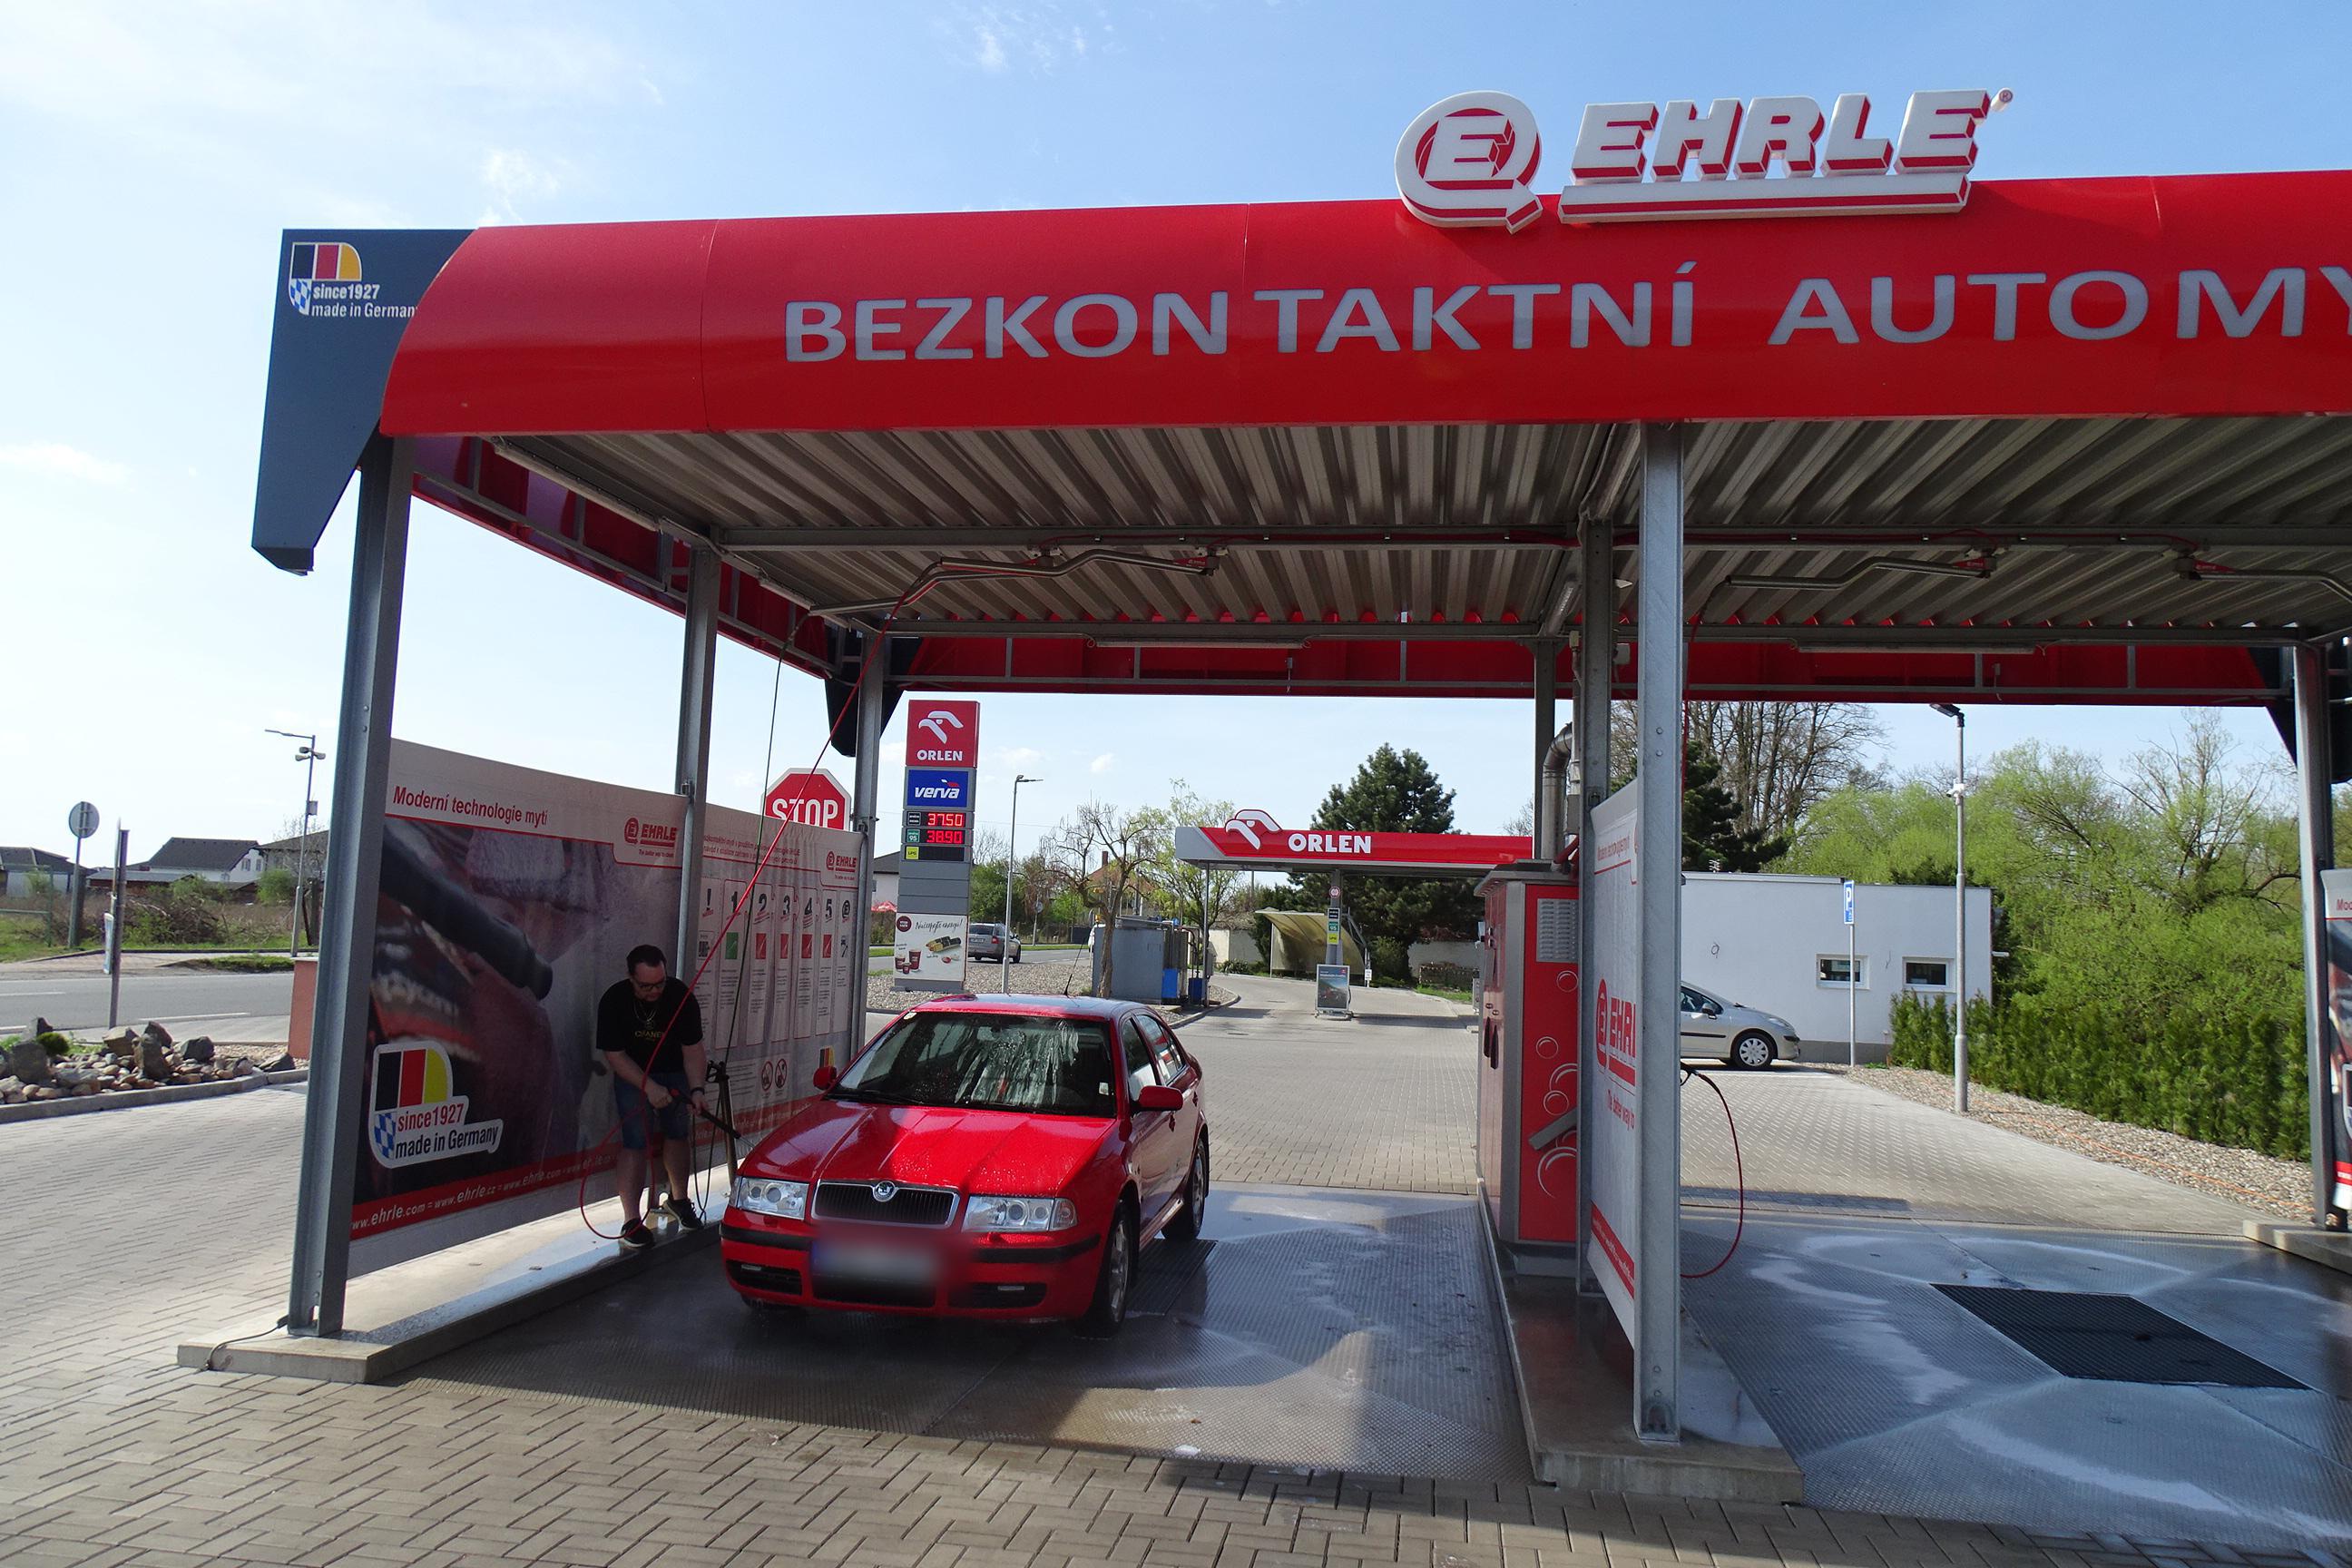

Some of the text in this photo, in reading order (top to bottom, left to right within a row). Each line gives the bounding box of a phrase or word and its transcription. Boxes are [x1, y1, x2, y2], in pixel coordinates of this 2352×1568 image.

[1571, 88, 1991, 185] EHRLE
[311, 302, 417, 318] made in German
[916, 749, 963, 761] ORLEN
[915, 787, 960, 799] verva
[393, 786, 450, 811] Moderní
[452, 797, 522, 824] technologie
[772, 799, 838, 828] STOP
[641, 823, 677, 841] EHRLE
[1288, 833, 1372, 854] ORLEN
[759, 893, 768, 912] 2
[782, 895, 790, 916] 3
[804, 897, 813, 915] 4
[825, 898, 833, 918] 5
[397, 1103, 464, 1132] since1927
[396, 1126, 499, 1159] made in Germany
[350, 1203, 426, 1230] ww.ehrle.com
